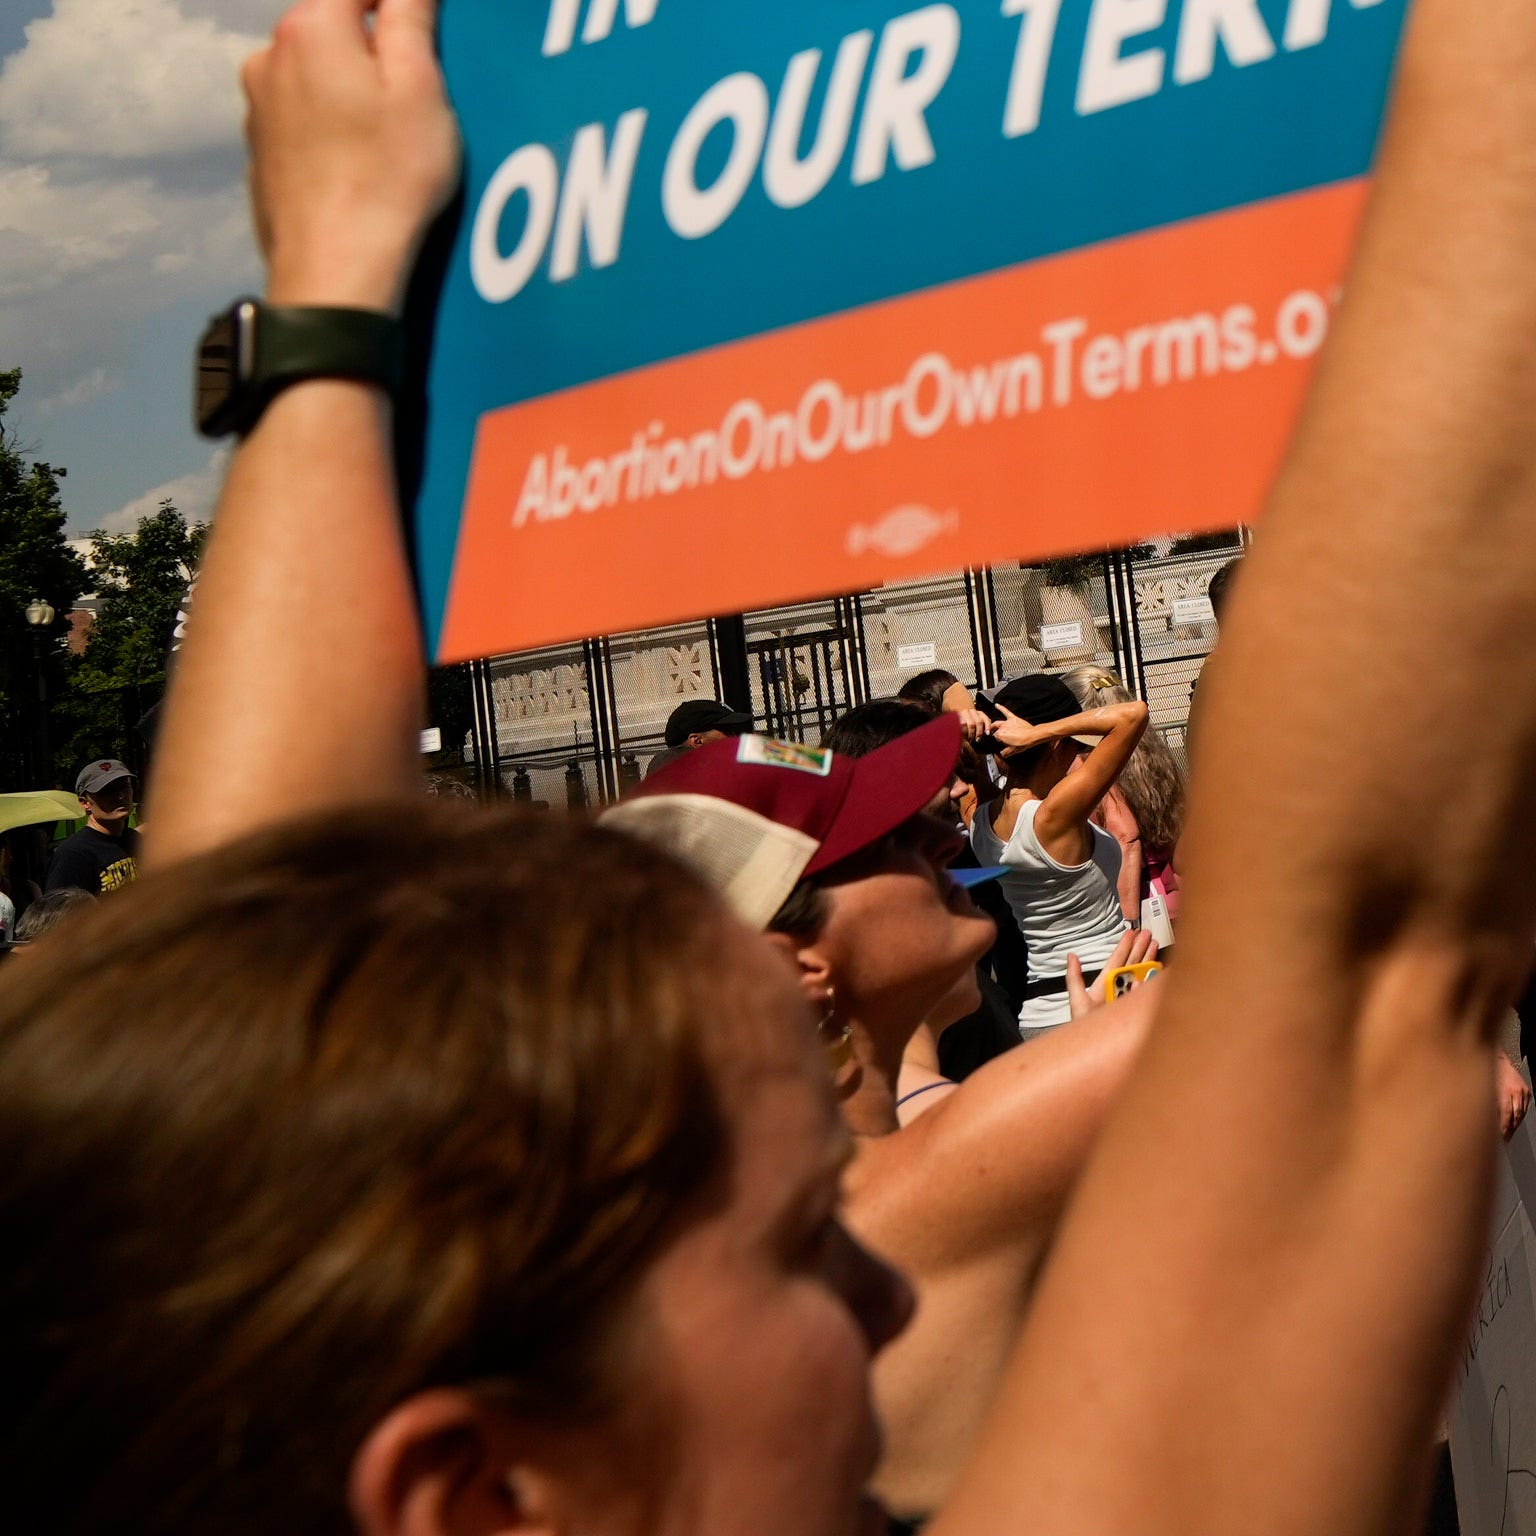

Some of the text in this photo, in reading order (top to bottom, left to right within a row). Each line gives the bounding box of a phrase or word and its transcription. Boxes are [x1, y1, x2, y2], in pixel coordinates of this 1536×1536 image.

[469, 107, 649, 305] ON
[660, 2, 961, 241] OUR
[511, 290, 1336, 528] AbortionOnOurOwnTerms.o
